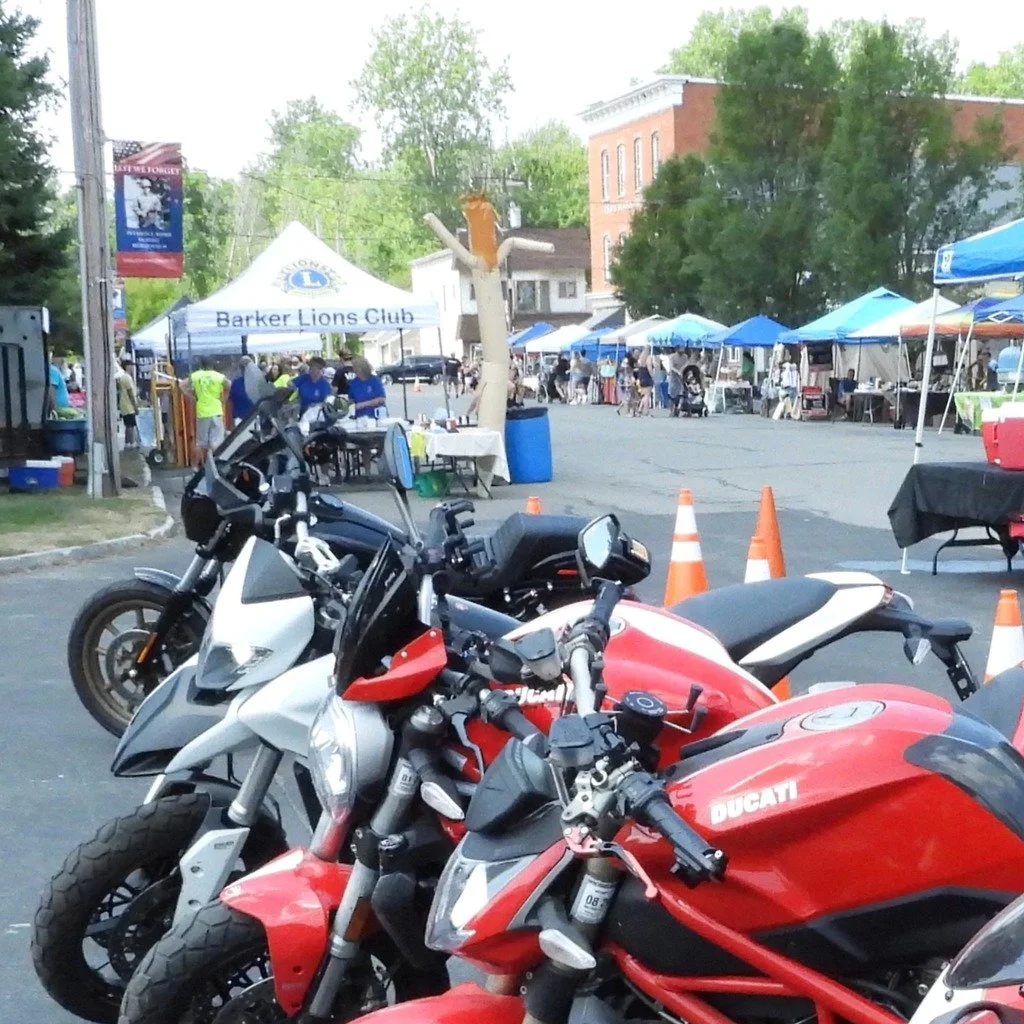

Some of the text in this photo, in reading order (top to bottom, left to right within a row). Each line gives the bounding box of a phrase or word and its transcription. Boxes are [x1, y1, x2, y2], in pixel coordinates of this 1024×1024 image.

[216, 307, 414, 327] Barker Lions Club
[711, 780, 798, 825] DUCATI
